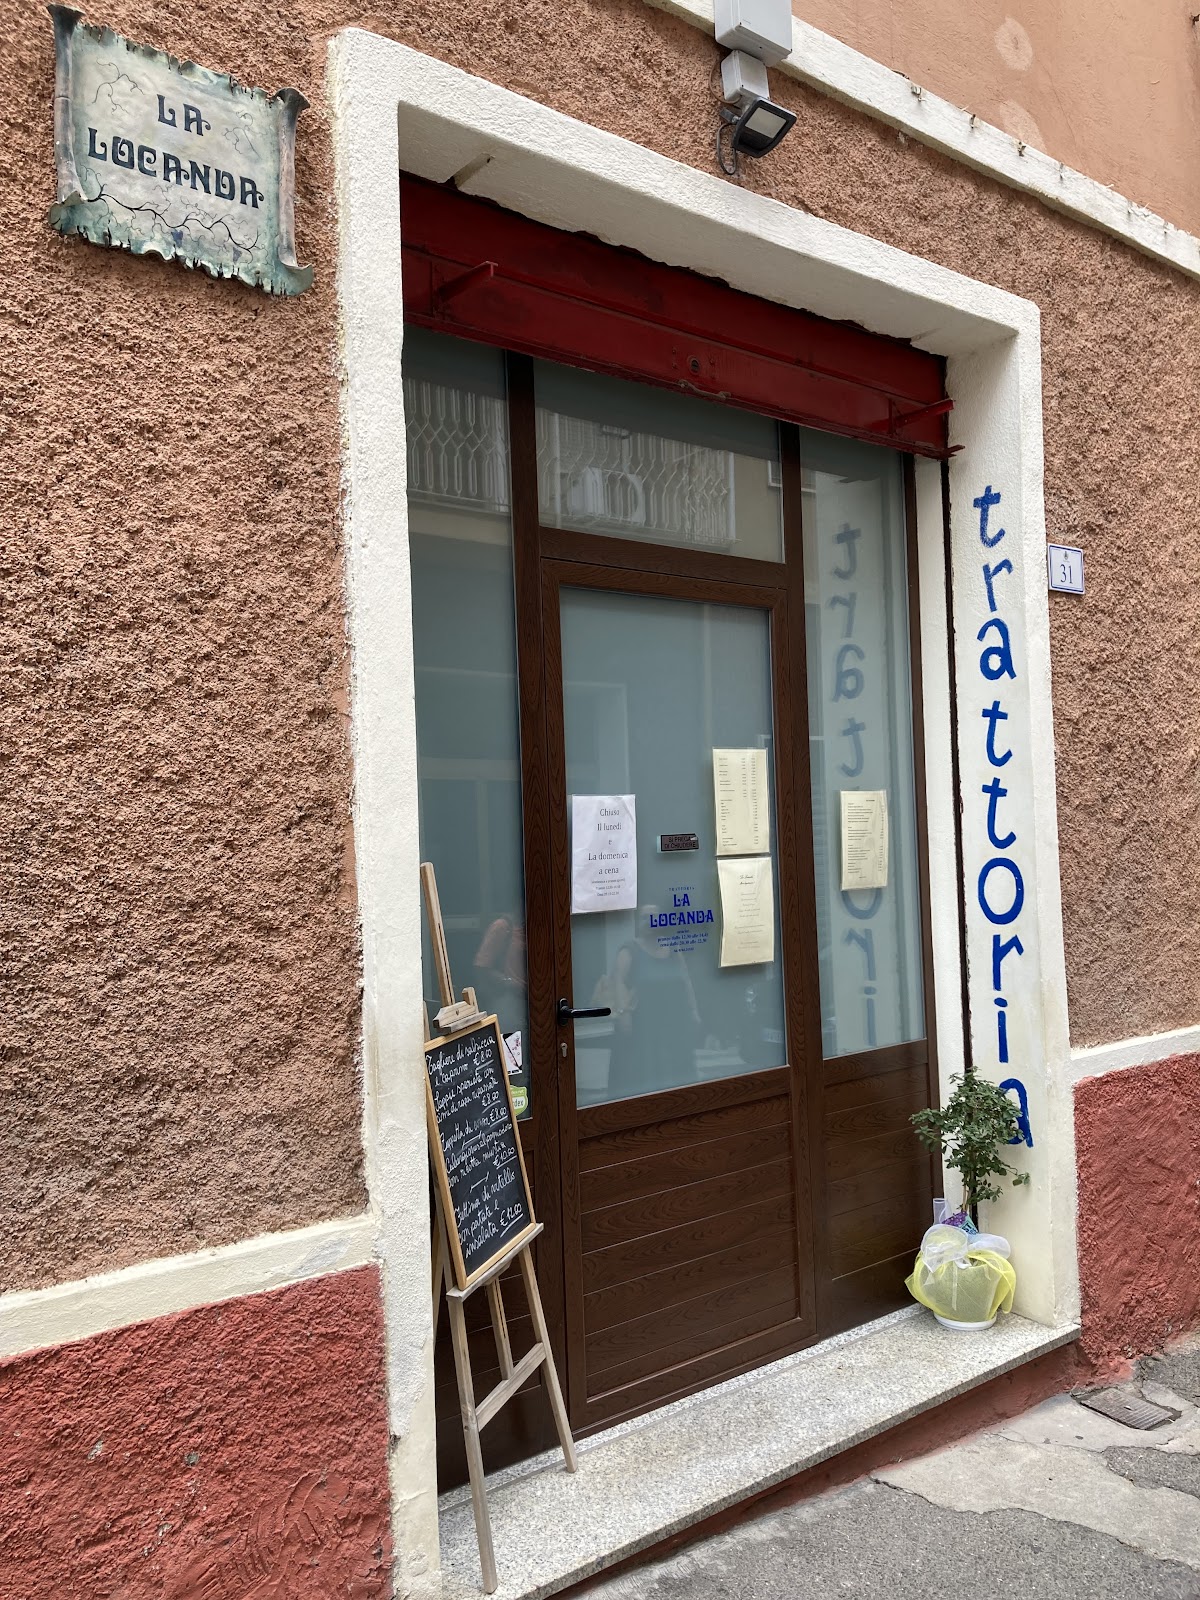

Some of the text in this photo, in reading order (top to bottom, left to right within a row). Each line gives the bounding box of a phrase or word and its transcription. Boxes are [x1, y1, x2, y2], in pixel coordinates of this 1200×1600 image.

[156, 94, 211, 136] LA
[87, 127, 265, 208] LOCANDA
[1060, 564, 1073, 584] 31
[600, 808, 620, 817] Chiuso
[597, 823, 602, 831] Il
[588, 852, 629, 861] La domenica
[673, 893, 690, 907] LA
[650, 909, 714, 928] LOCANDA
